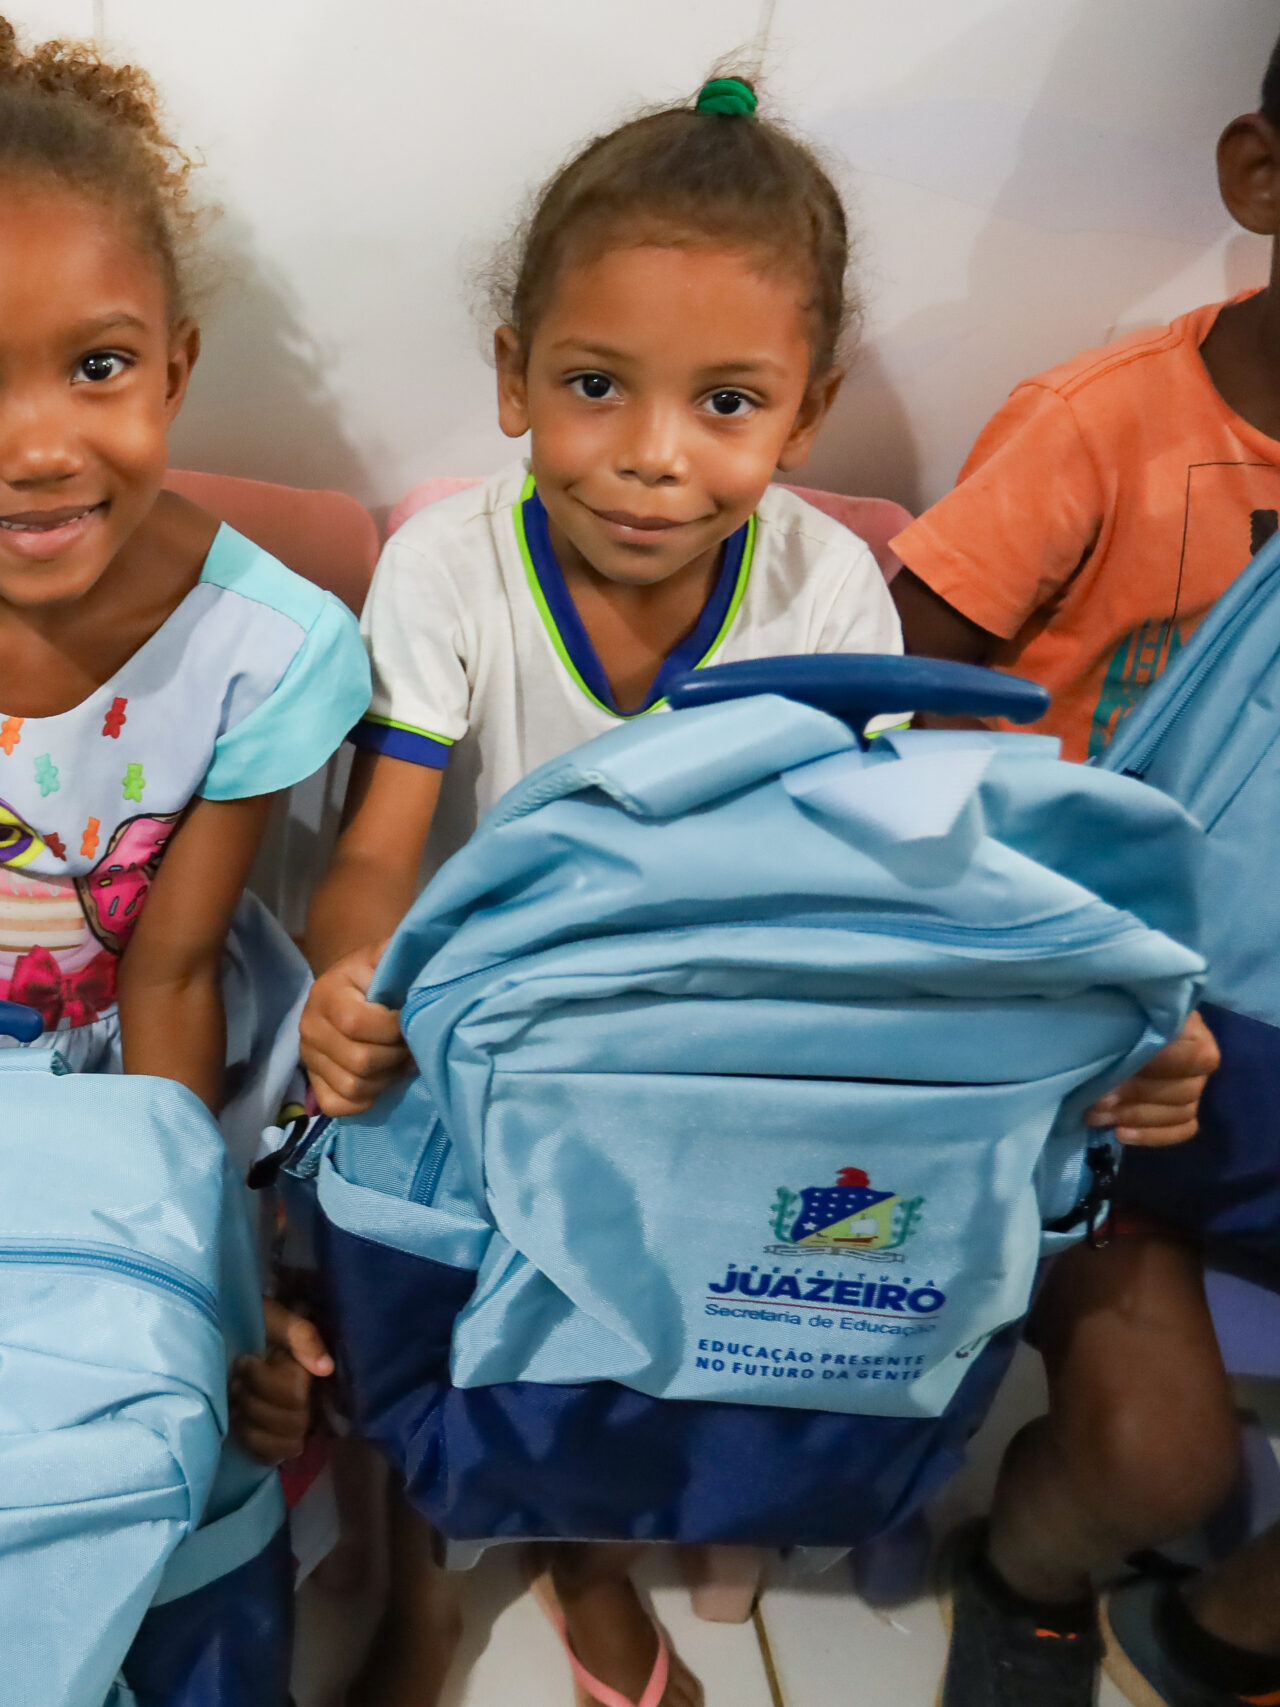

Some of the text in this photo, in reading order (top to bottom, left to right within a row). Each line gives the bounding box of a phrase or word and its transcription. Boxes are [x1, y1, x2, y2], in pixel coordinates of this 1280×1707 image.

[708, 1271, 946, 1313] JUAZEIRO
[704, 1303, 801, 1325] Secretaria
[808, 1315, 834, 1328] de
[698, 1339, 925, 1365] EDUCAÇÃO PRESENTE
[696, 1356, 725, 1372] NO
[732, 1362, 814, 1379] FUTURO
[822, 1369, 849, 1379] DA
